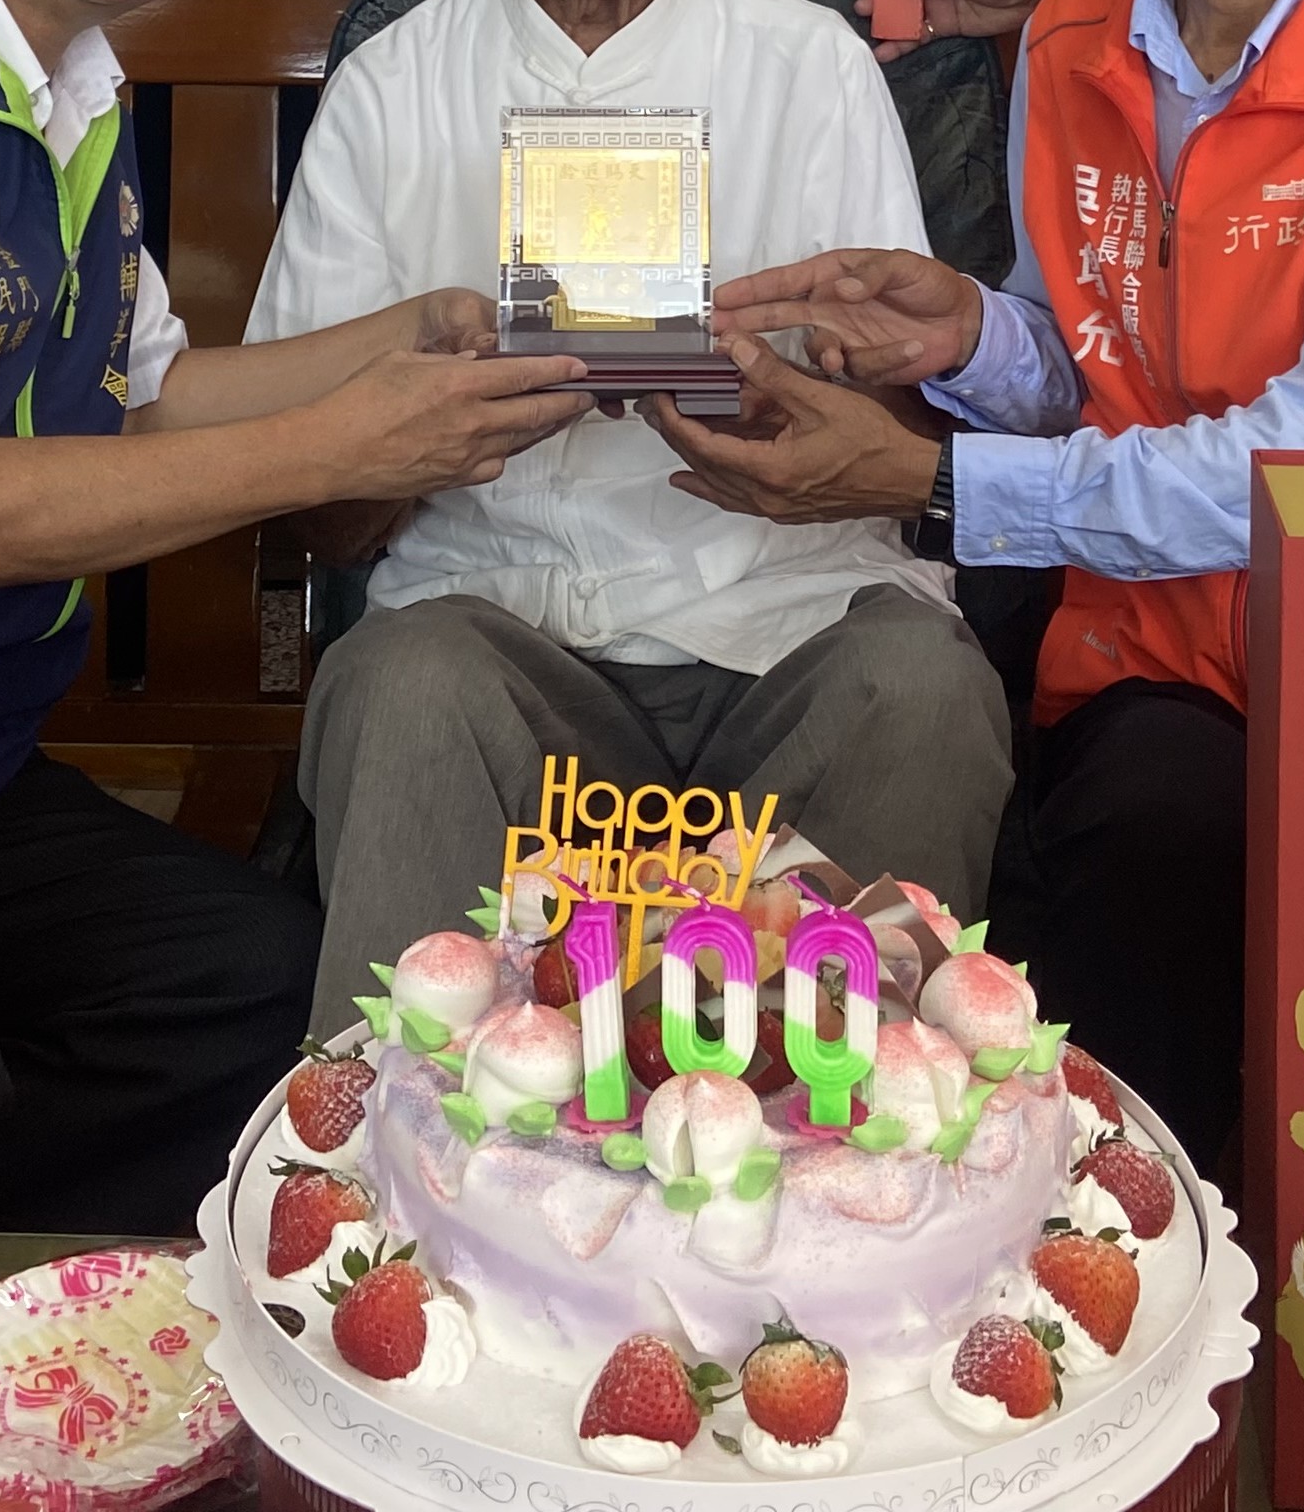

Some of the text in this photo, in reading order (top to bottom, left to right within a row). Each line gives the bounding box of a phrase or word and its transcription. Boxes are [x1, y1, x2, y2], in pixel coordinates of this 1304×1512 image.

[1097, 173, 1132, 265] 執行長
[564, 900, 879, 1125] 100
